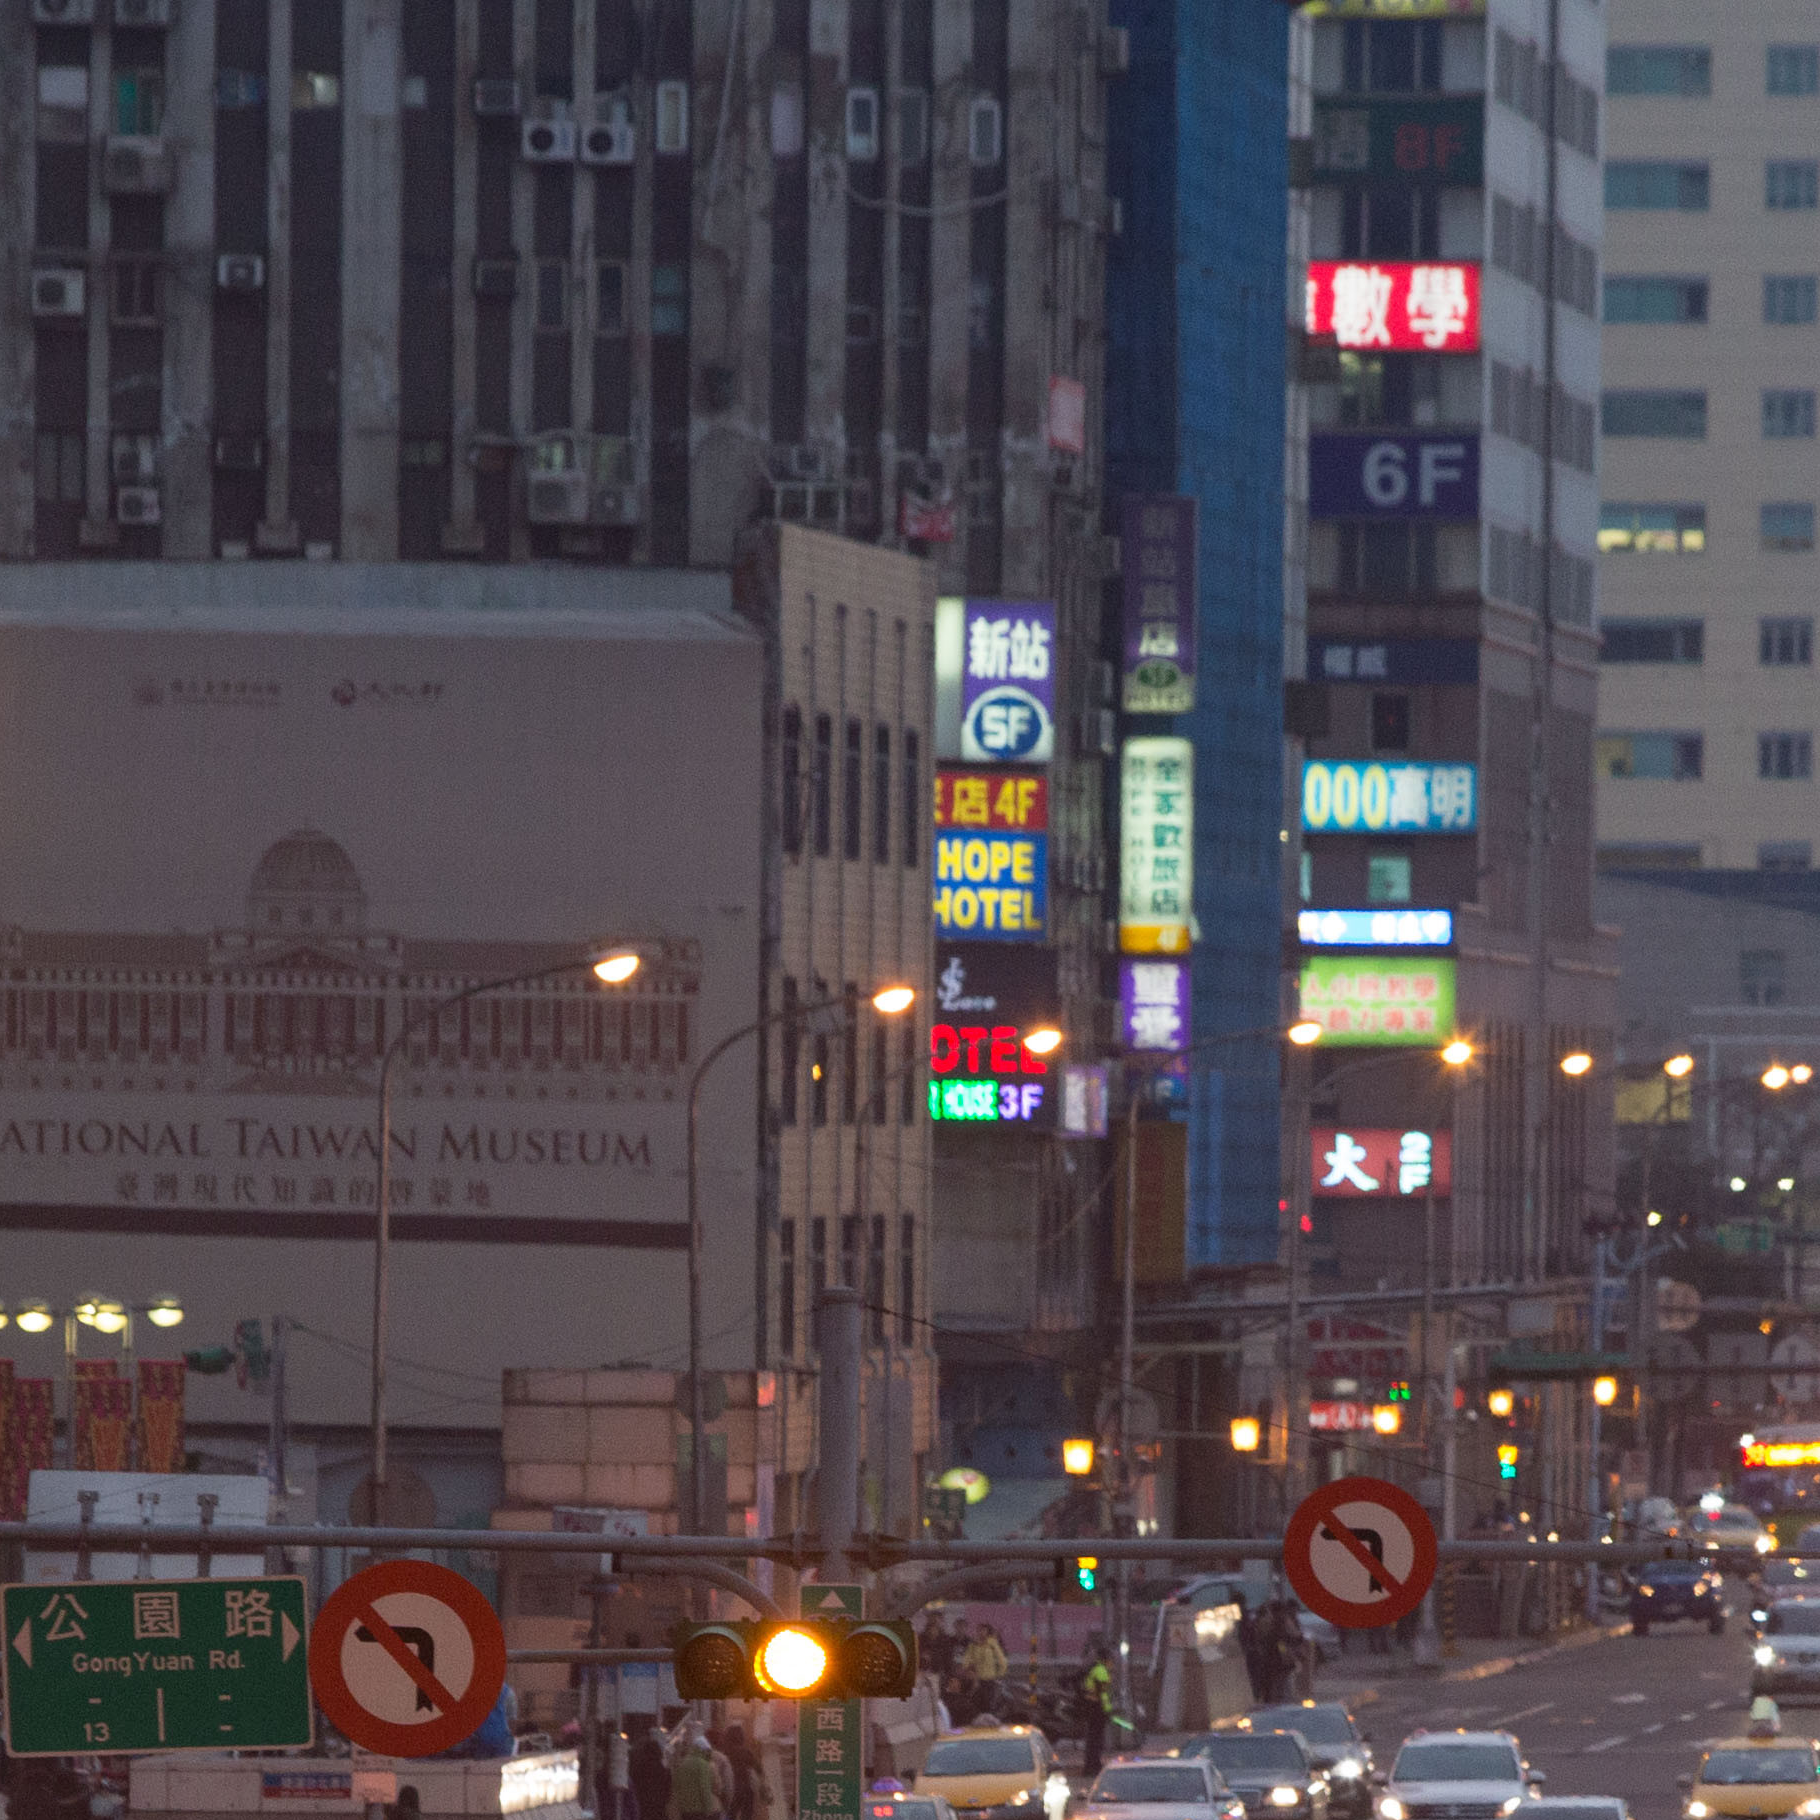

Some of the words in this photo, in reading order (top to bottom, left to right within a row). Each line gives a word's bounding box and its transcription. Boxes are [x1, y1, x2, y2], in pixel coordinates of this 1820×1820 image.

[1306, 263, 1469, 349] 數學
[1361, 442, 1466, 507] 6F
[969, 615, 1050, 682] 新站
[982, 703, 1032, 751] SF
[938, 838, 1035, 883] HOPE
[999, 1083, 1044, 1121] 3F
[226, 1117, 418, 1162] TAIWAN
[437, 1123, 654, 1168] MUSEUM
[40, 1587, 275, 1643] 公園路
[72, 1650, 196, 1677] GongYuan
[209, 1648, 246, 1671] Rd.
[83, 1721, 111, 1743] 13
